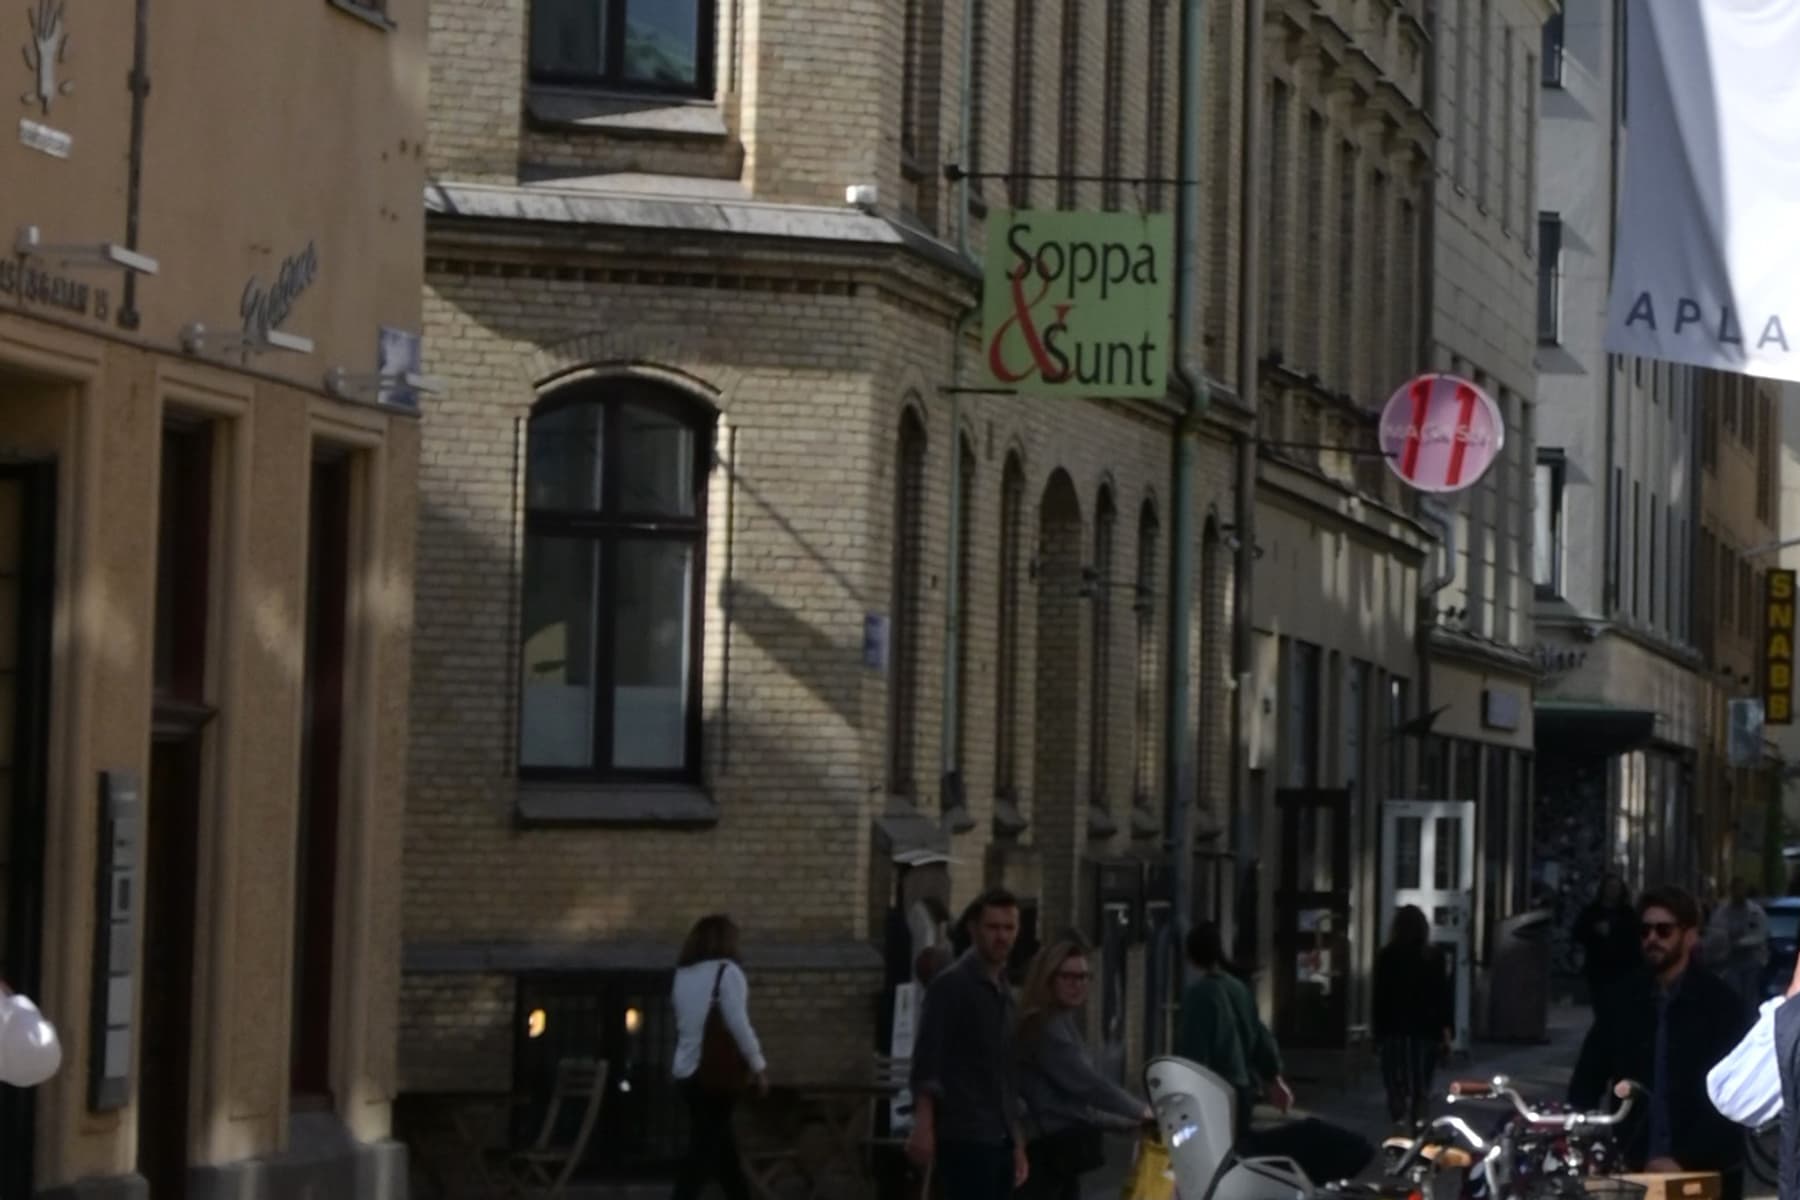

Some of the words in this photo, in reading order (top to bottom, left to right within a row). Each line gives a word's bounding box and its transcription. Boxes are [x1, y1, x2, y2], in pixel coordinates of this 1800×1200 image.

[1005, 224, 1158, 300] Soppa
[989, 260, 1074, 384] &
[1041, 322, 1157, 387] Sunt
[1768, 573, 1792, 721] SNABB
